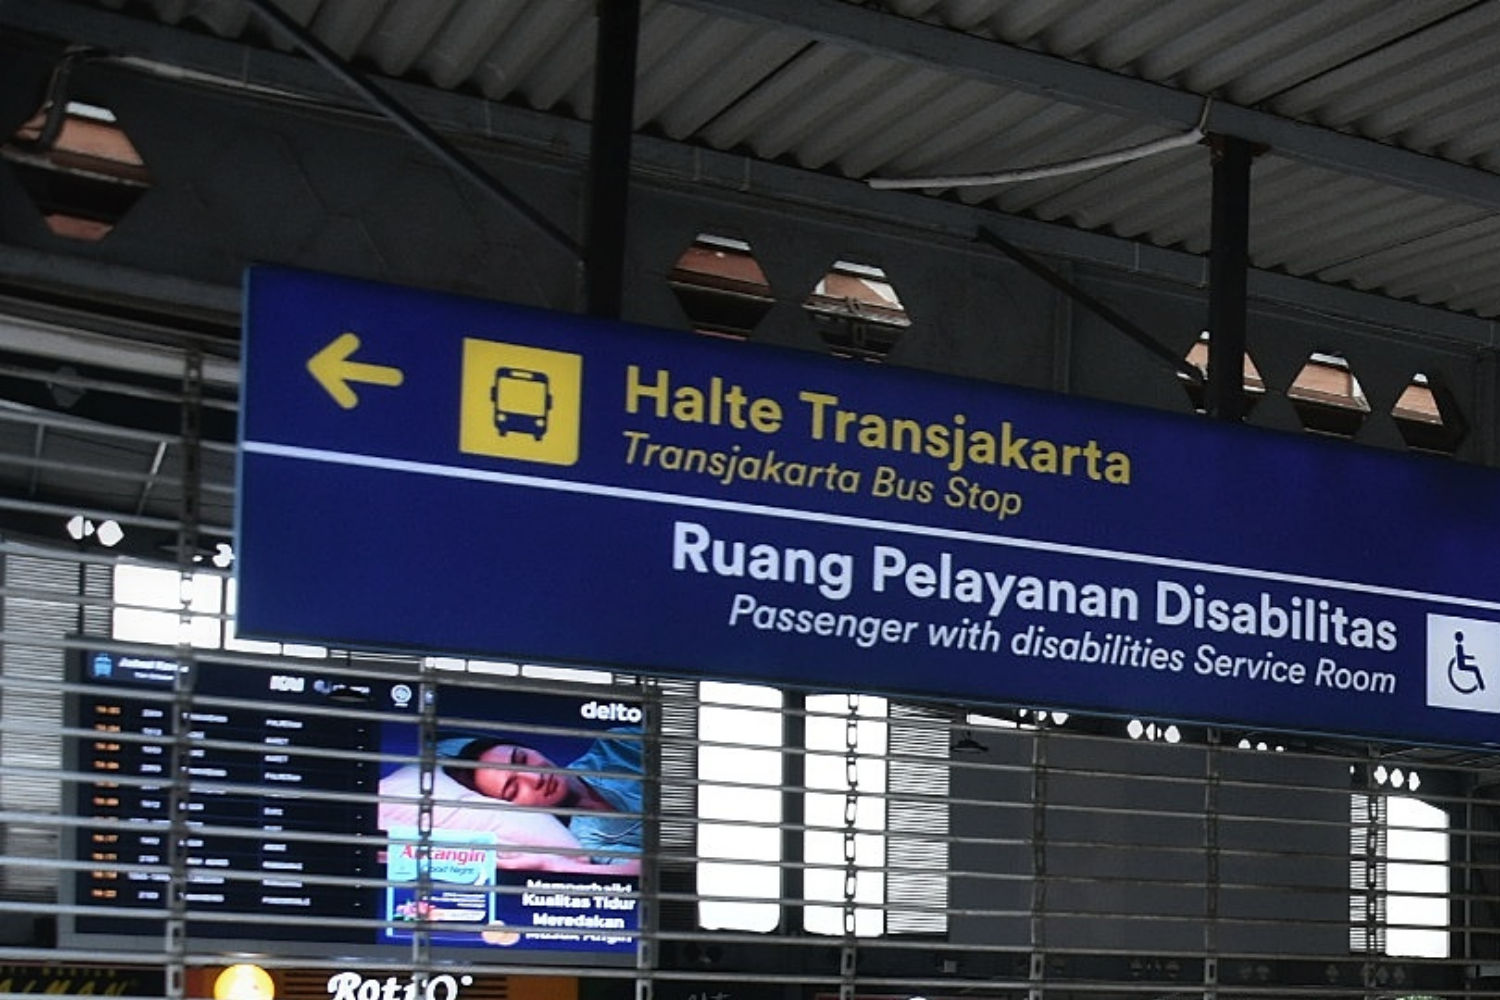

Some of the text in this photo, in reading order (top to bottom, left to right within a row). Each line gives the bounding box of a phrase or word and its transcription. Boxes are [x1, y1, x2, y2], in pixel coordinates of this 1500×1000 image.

[624, 364, 1132, 485] Halte Transjakarta
[622, 430, 1023, 520] Transjakarta Bus Stop
[672, 520, 1398, 652] Ruang Pelayanan Disabilitas
[728, 593, 1397, 694] Passenger with disabilities Service Room
[522, 892, 637, 911] Kualitas Tidur
[532, 913, 626, 929] Meredakan
